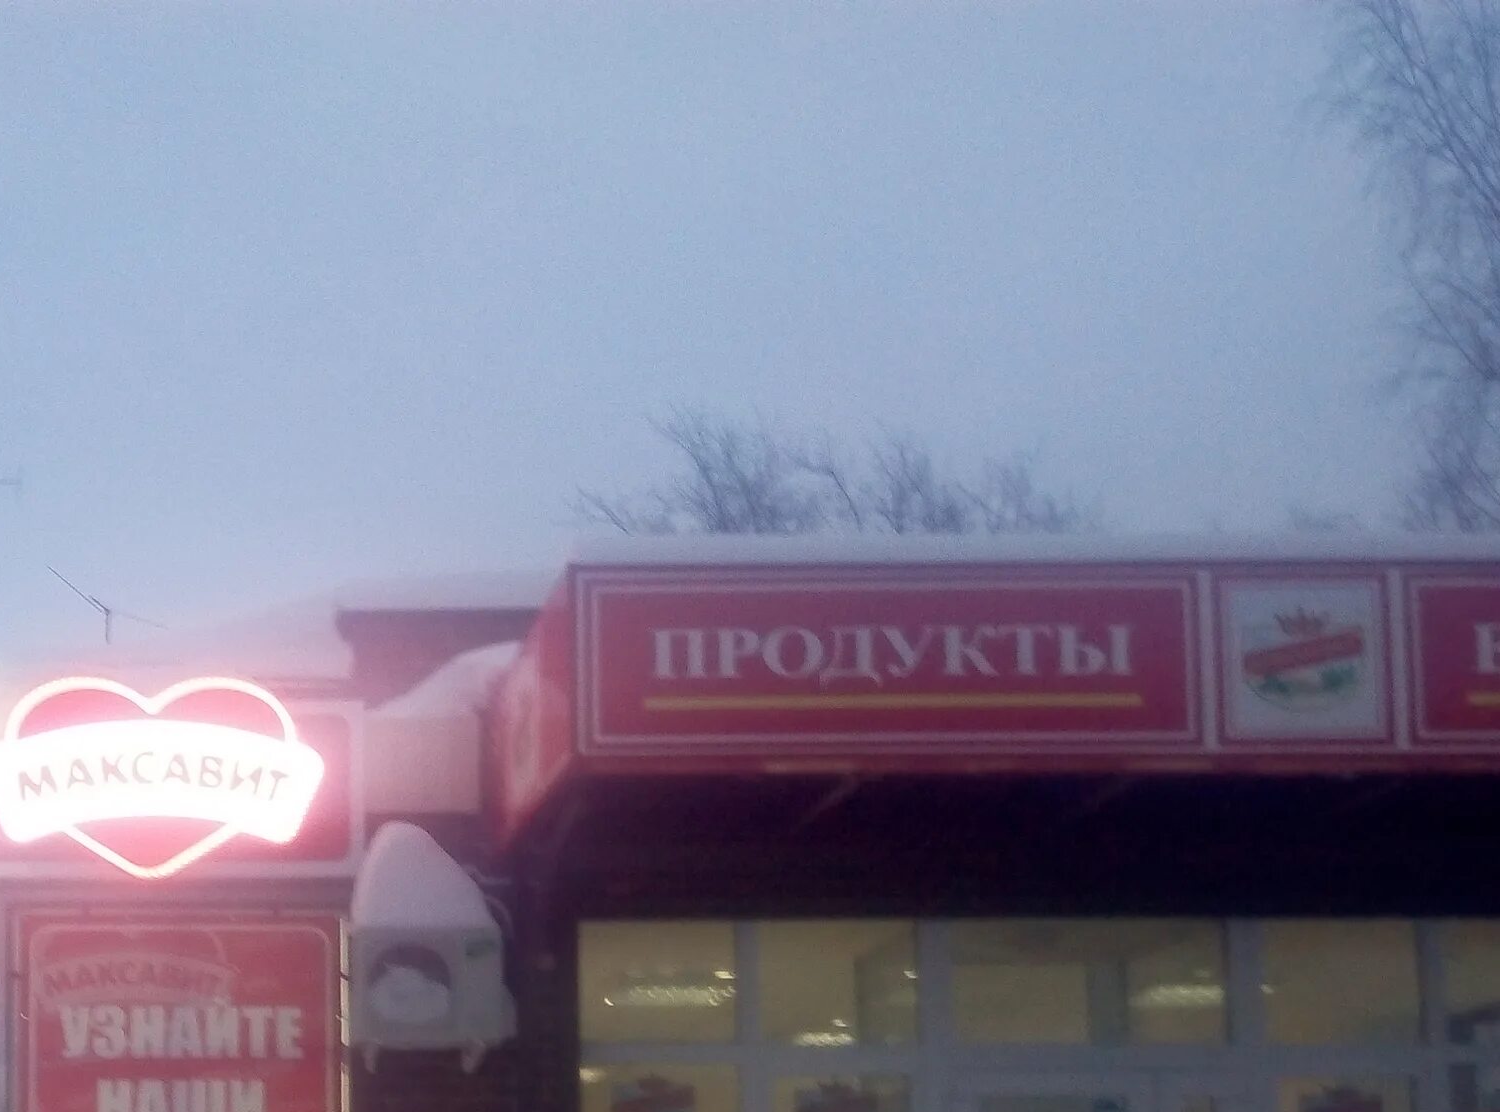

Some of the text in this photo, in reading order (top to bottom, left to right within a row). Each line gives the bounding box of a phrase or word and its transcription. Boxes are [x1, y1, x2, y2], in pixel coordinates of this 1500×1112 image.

[650, 621, 1133, 688] ПРОДУКТЫ
[17, 750, 290, 802] МАКСАВИТ
[59, 995, 305, 1060] УЗНАЙТЕ
